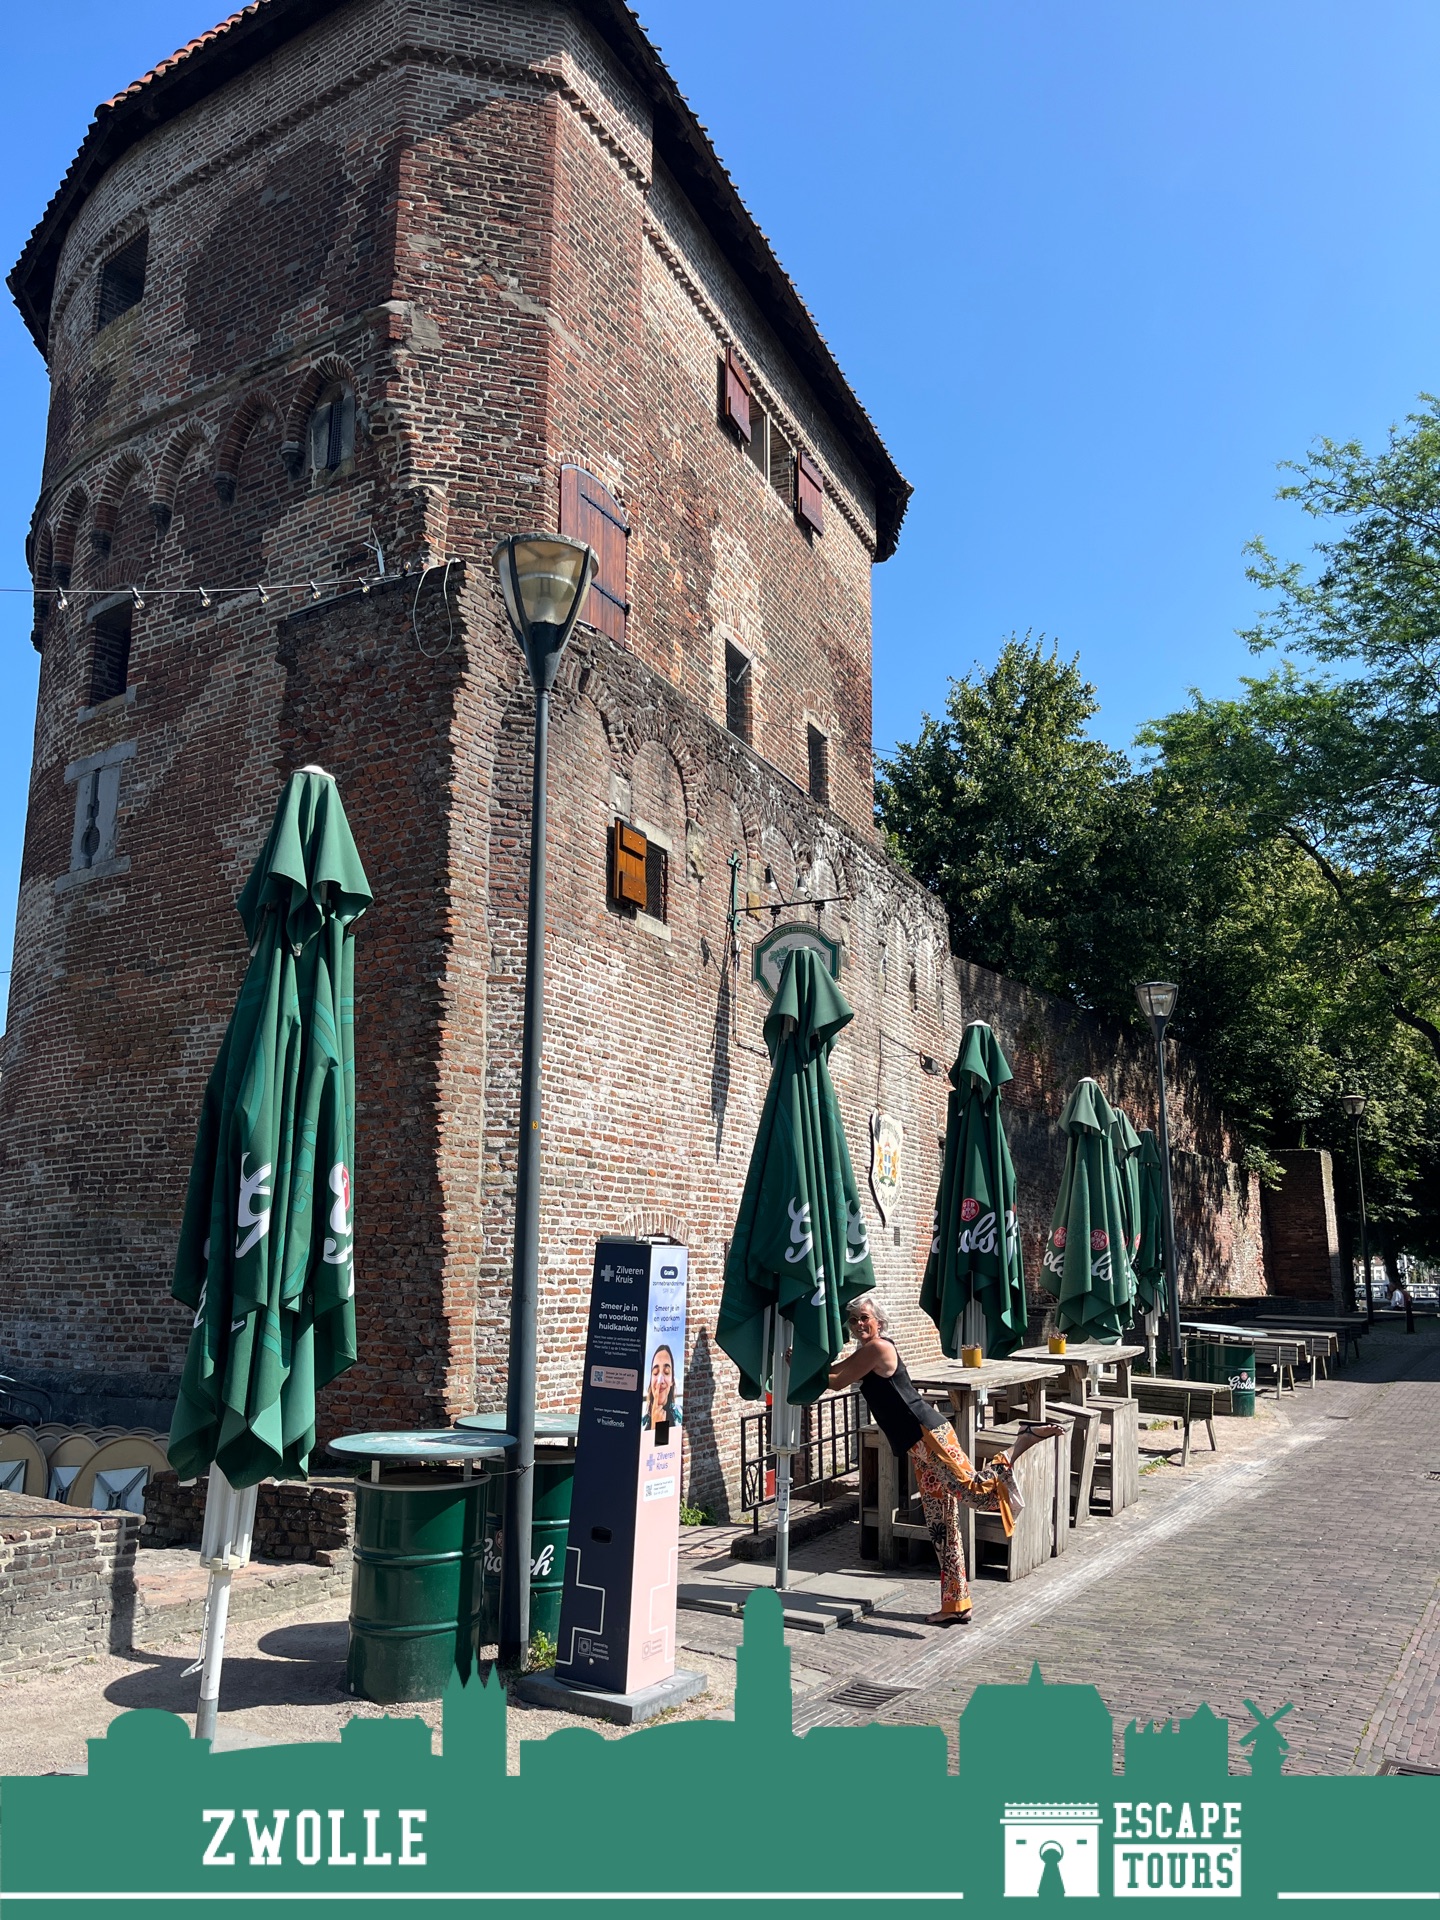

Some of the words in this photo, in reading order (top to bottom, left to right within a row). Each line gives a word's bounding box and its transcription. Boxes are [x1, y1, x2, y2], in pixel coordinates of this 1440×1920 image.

[616, 1265, 644, 1275] Zilveren
[615, 1275, 634, 1284] Kruis
[600, 1301, 623, 1311] Smeer
[622, 1303, 631, 1312] je
[631, 1304, 639, 1312] in
[654, 1304, 669, 1312] Smeer
[669, 1304, 675, 1312] je
[608, 1313, 639, 1322] voorkom
[598, 1322, 638, 1333] huidkanker
[653, 1325, 680, 1333] huidkanker
[656, 1452, 675, 1460] Zilveren
